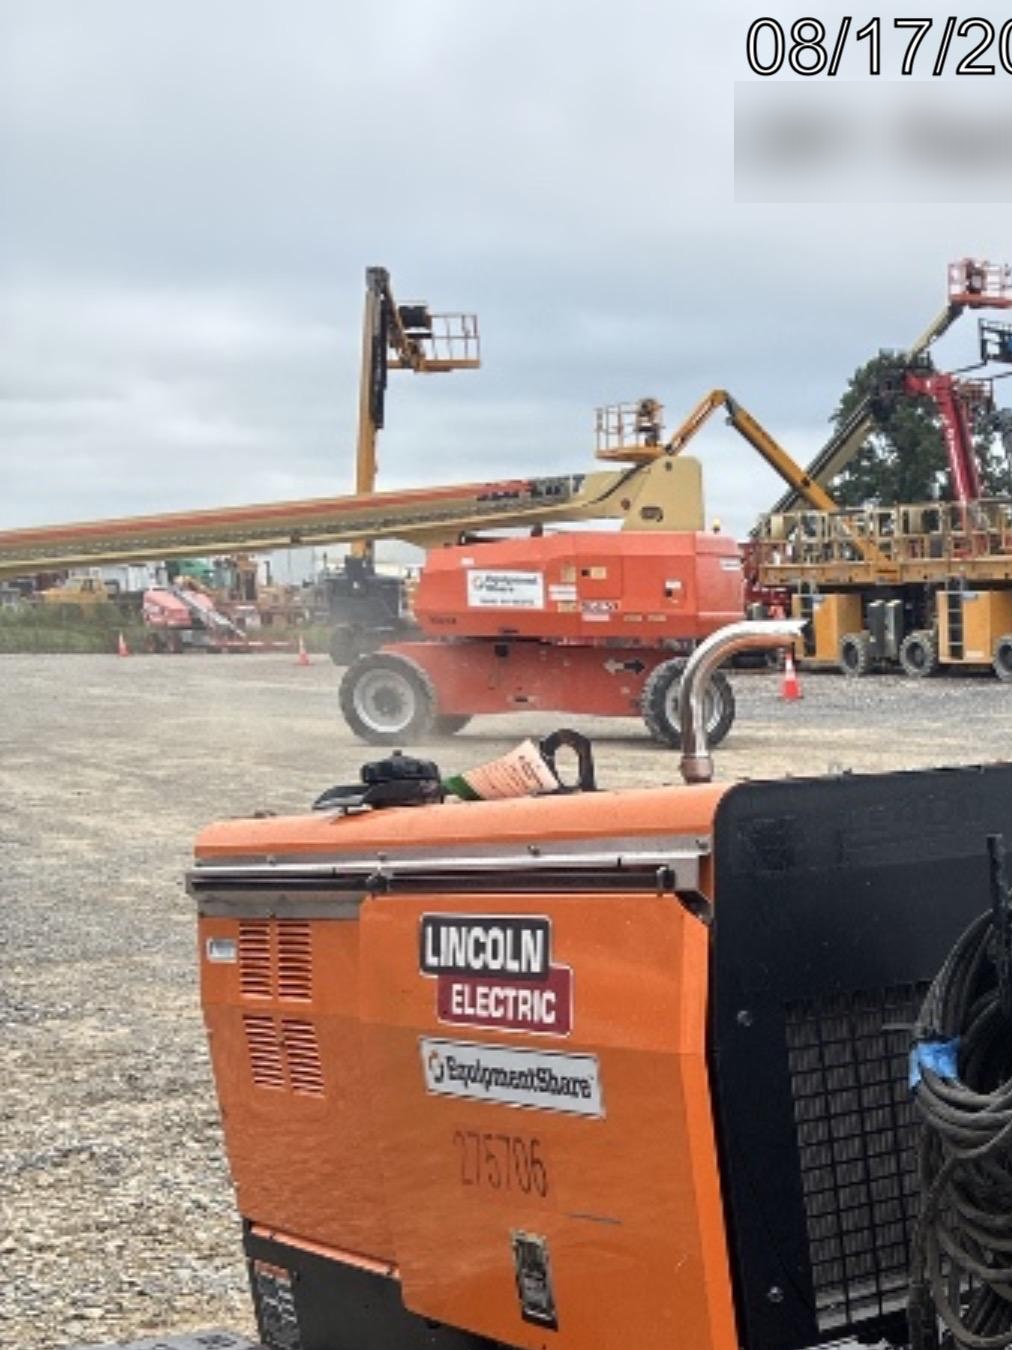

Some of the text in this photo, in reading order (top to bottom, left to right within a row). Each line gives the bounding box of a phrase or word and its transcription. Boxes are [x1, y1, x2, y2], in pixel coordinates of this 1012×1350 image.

[425, 924, 544, 973] LINCOLN
[451, 982, 556, 1024] ELECTRIC
[446, 1055, 592, 1099] EquipmentShare
